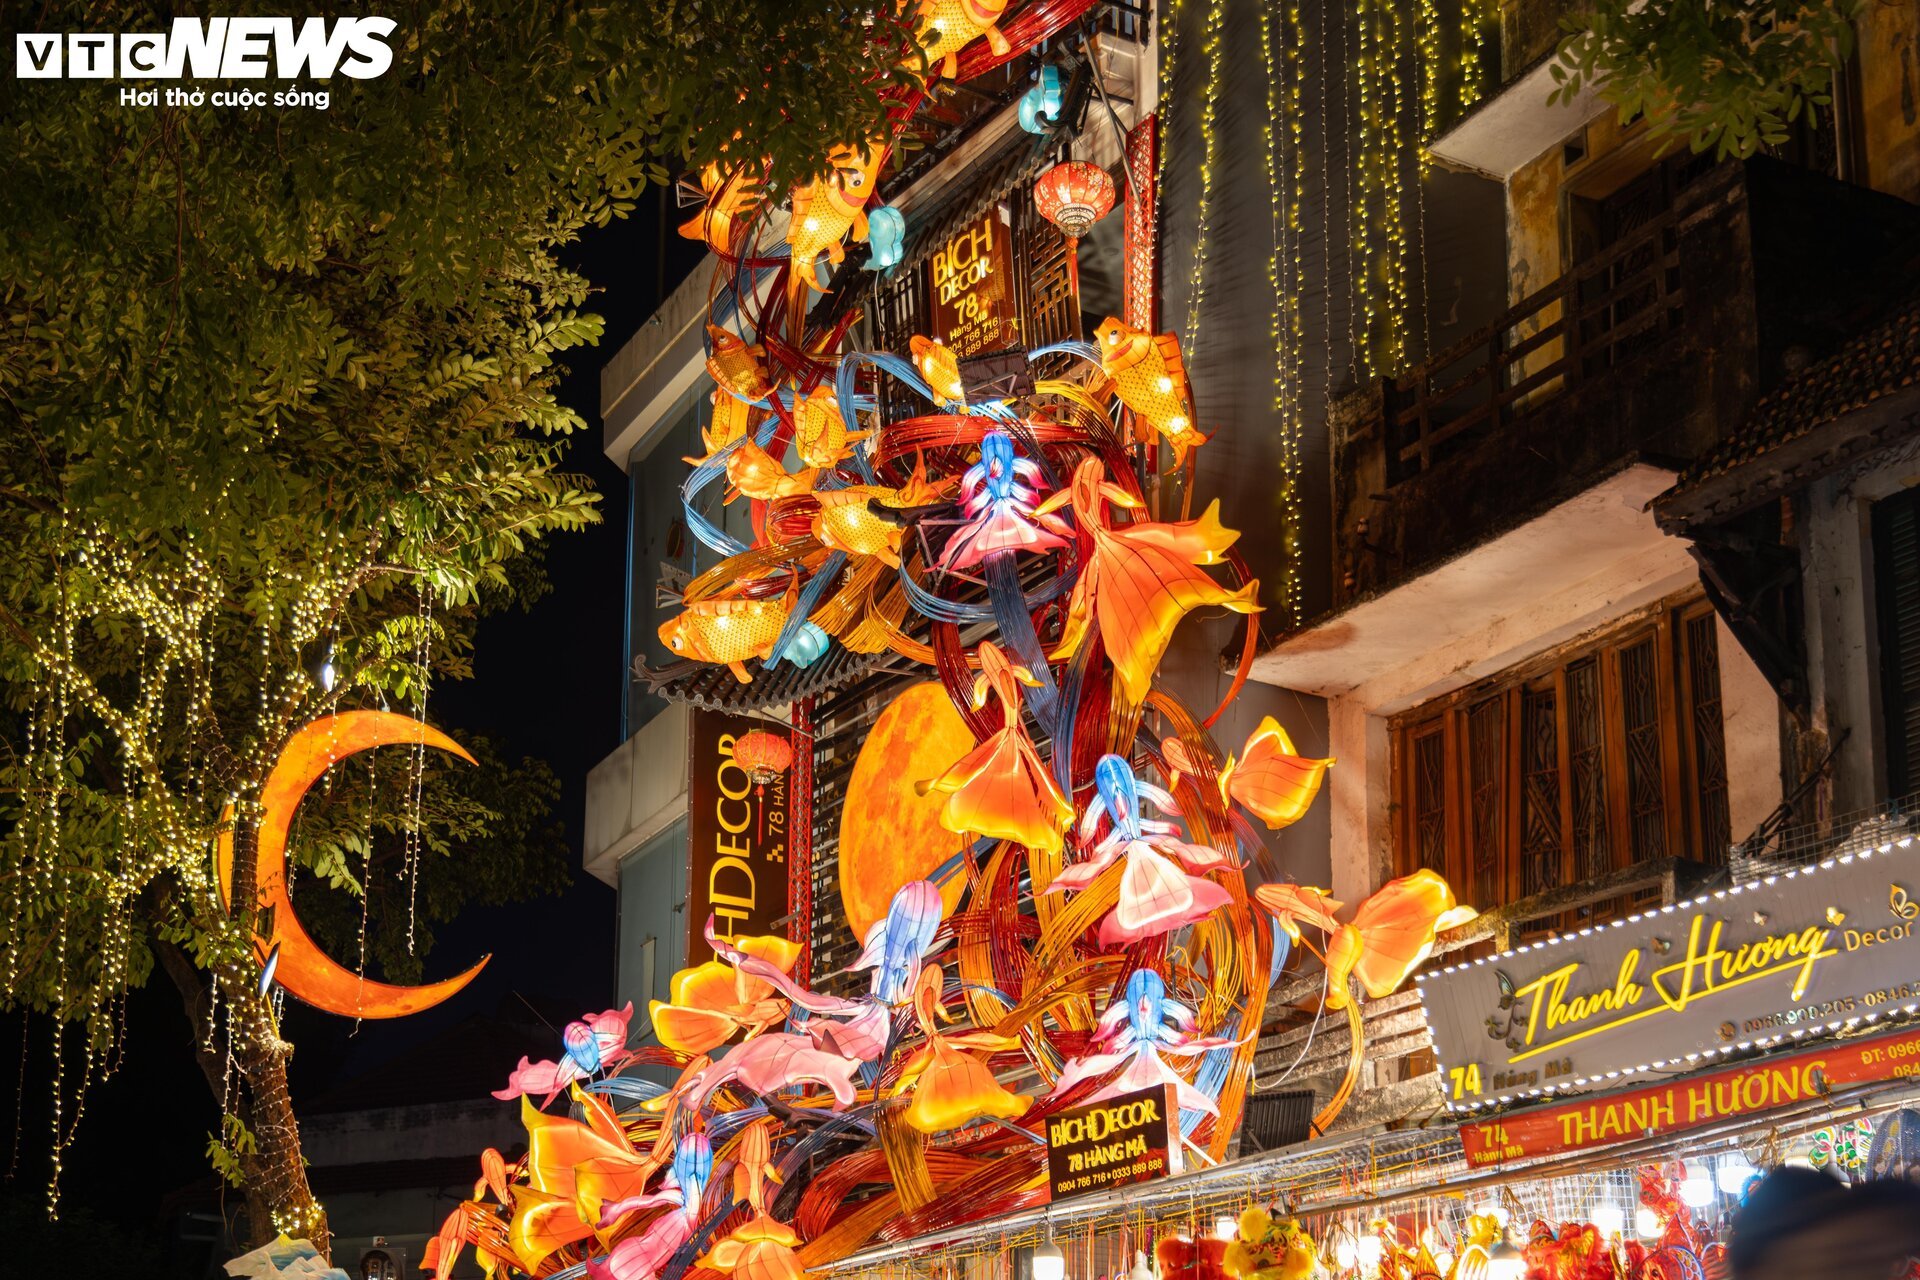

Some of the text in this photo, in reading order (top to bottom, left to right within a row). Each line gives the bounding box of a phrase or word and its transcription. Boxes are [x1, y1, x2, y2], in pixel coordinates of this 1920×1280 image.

[940, 256, 993, 305] DECOR
[954, 292, 979, 324] 78
[982, 317, 998, 333] 716
[769, 771, 785, 836] 78 HÀN
[1844, 921, 1913, 951] Decor
[1515, 914, 1830, 1045] Thanh Hương
[1450, 1063, 1481, 1100] 74
[1557, 1089, 1675, 1145] THANH
[1480, 1124, 1509, 1148] 74
[1058, 1179, 1076, 1193] 0904
[1077, 1175, 1091, 1188] 766
[1093, 1172, 1106, 1184] 716
[1112, 1166, 1131, 1180] 0333
[1148, 1158, 1163, 1171] 888
[1068, 1154, 1084, 1173] 78
[1084, 1144, 1125, 1168] HÀNG
